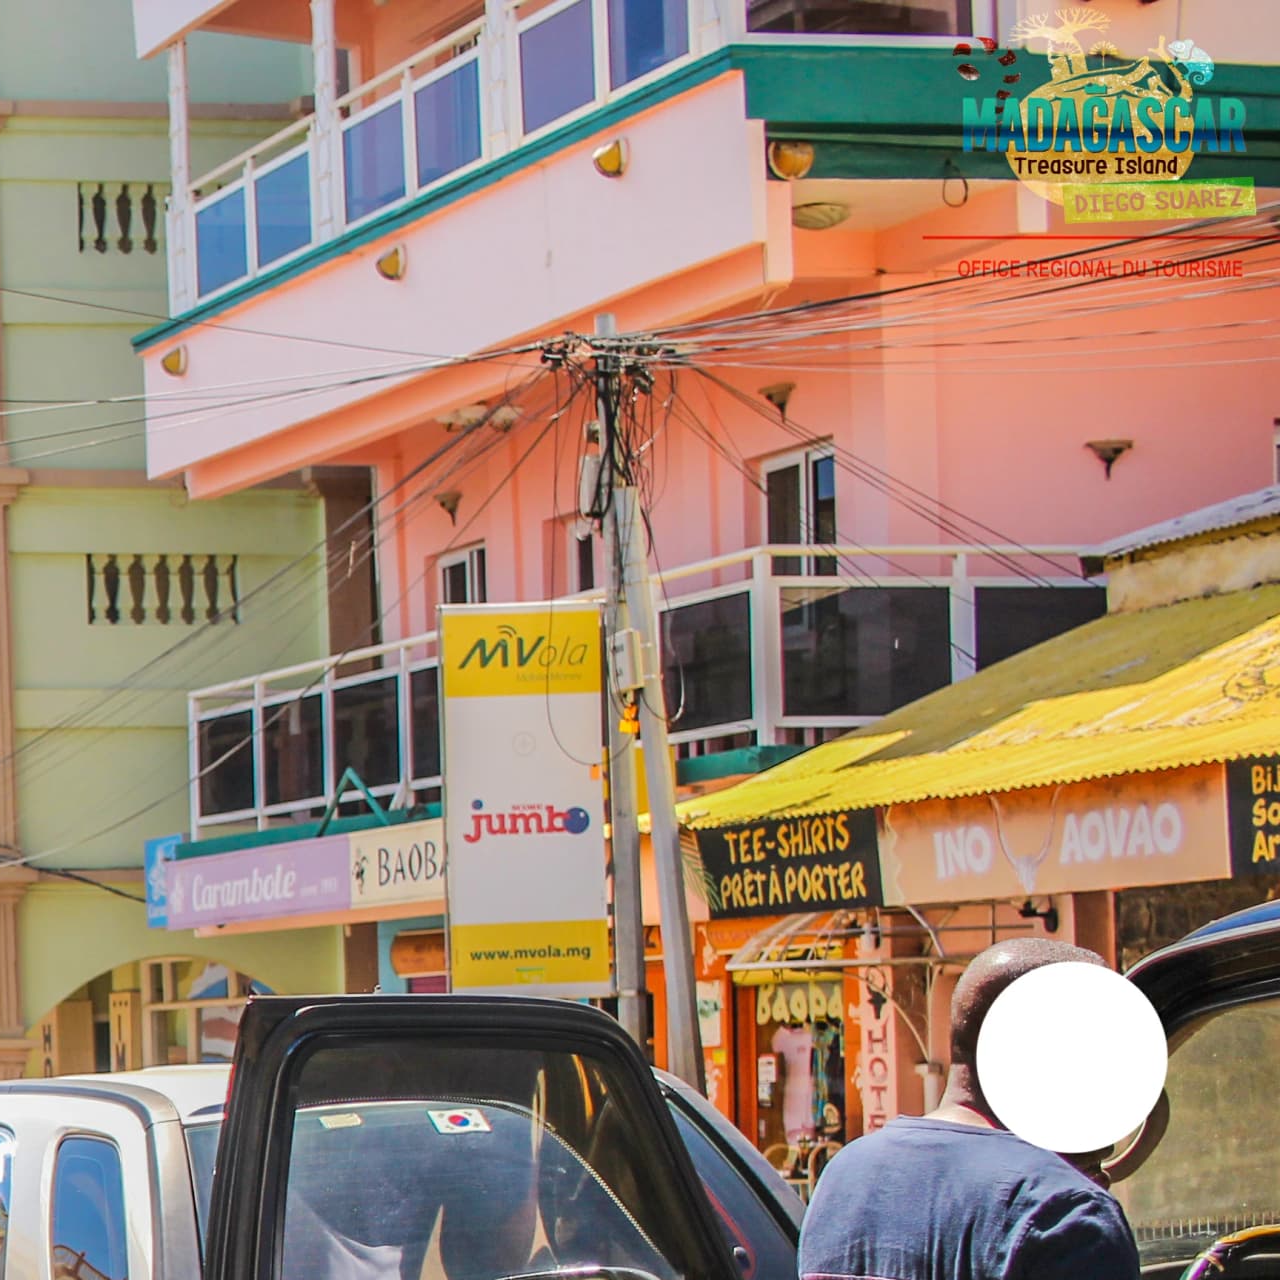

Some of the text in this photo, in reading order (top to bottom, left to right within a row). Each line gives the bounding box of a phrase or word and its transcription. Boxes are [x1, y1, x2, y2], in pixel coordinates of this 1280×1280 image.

[458, 635, 588, 669] MVola
[463, 799, 590, 843] jumbo
[724, 813, 850, 865] TEE-SHIRTS
[932, 802, 1182, 880] INO AOVAO
[784, 860, 867, 904] PORTER
[470, 945, 591, 961] www.mvola.mg
